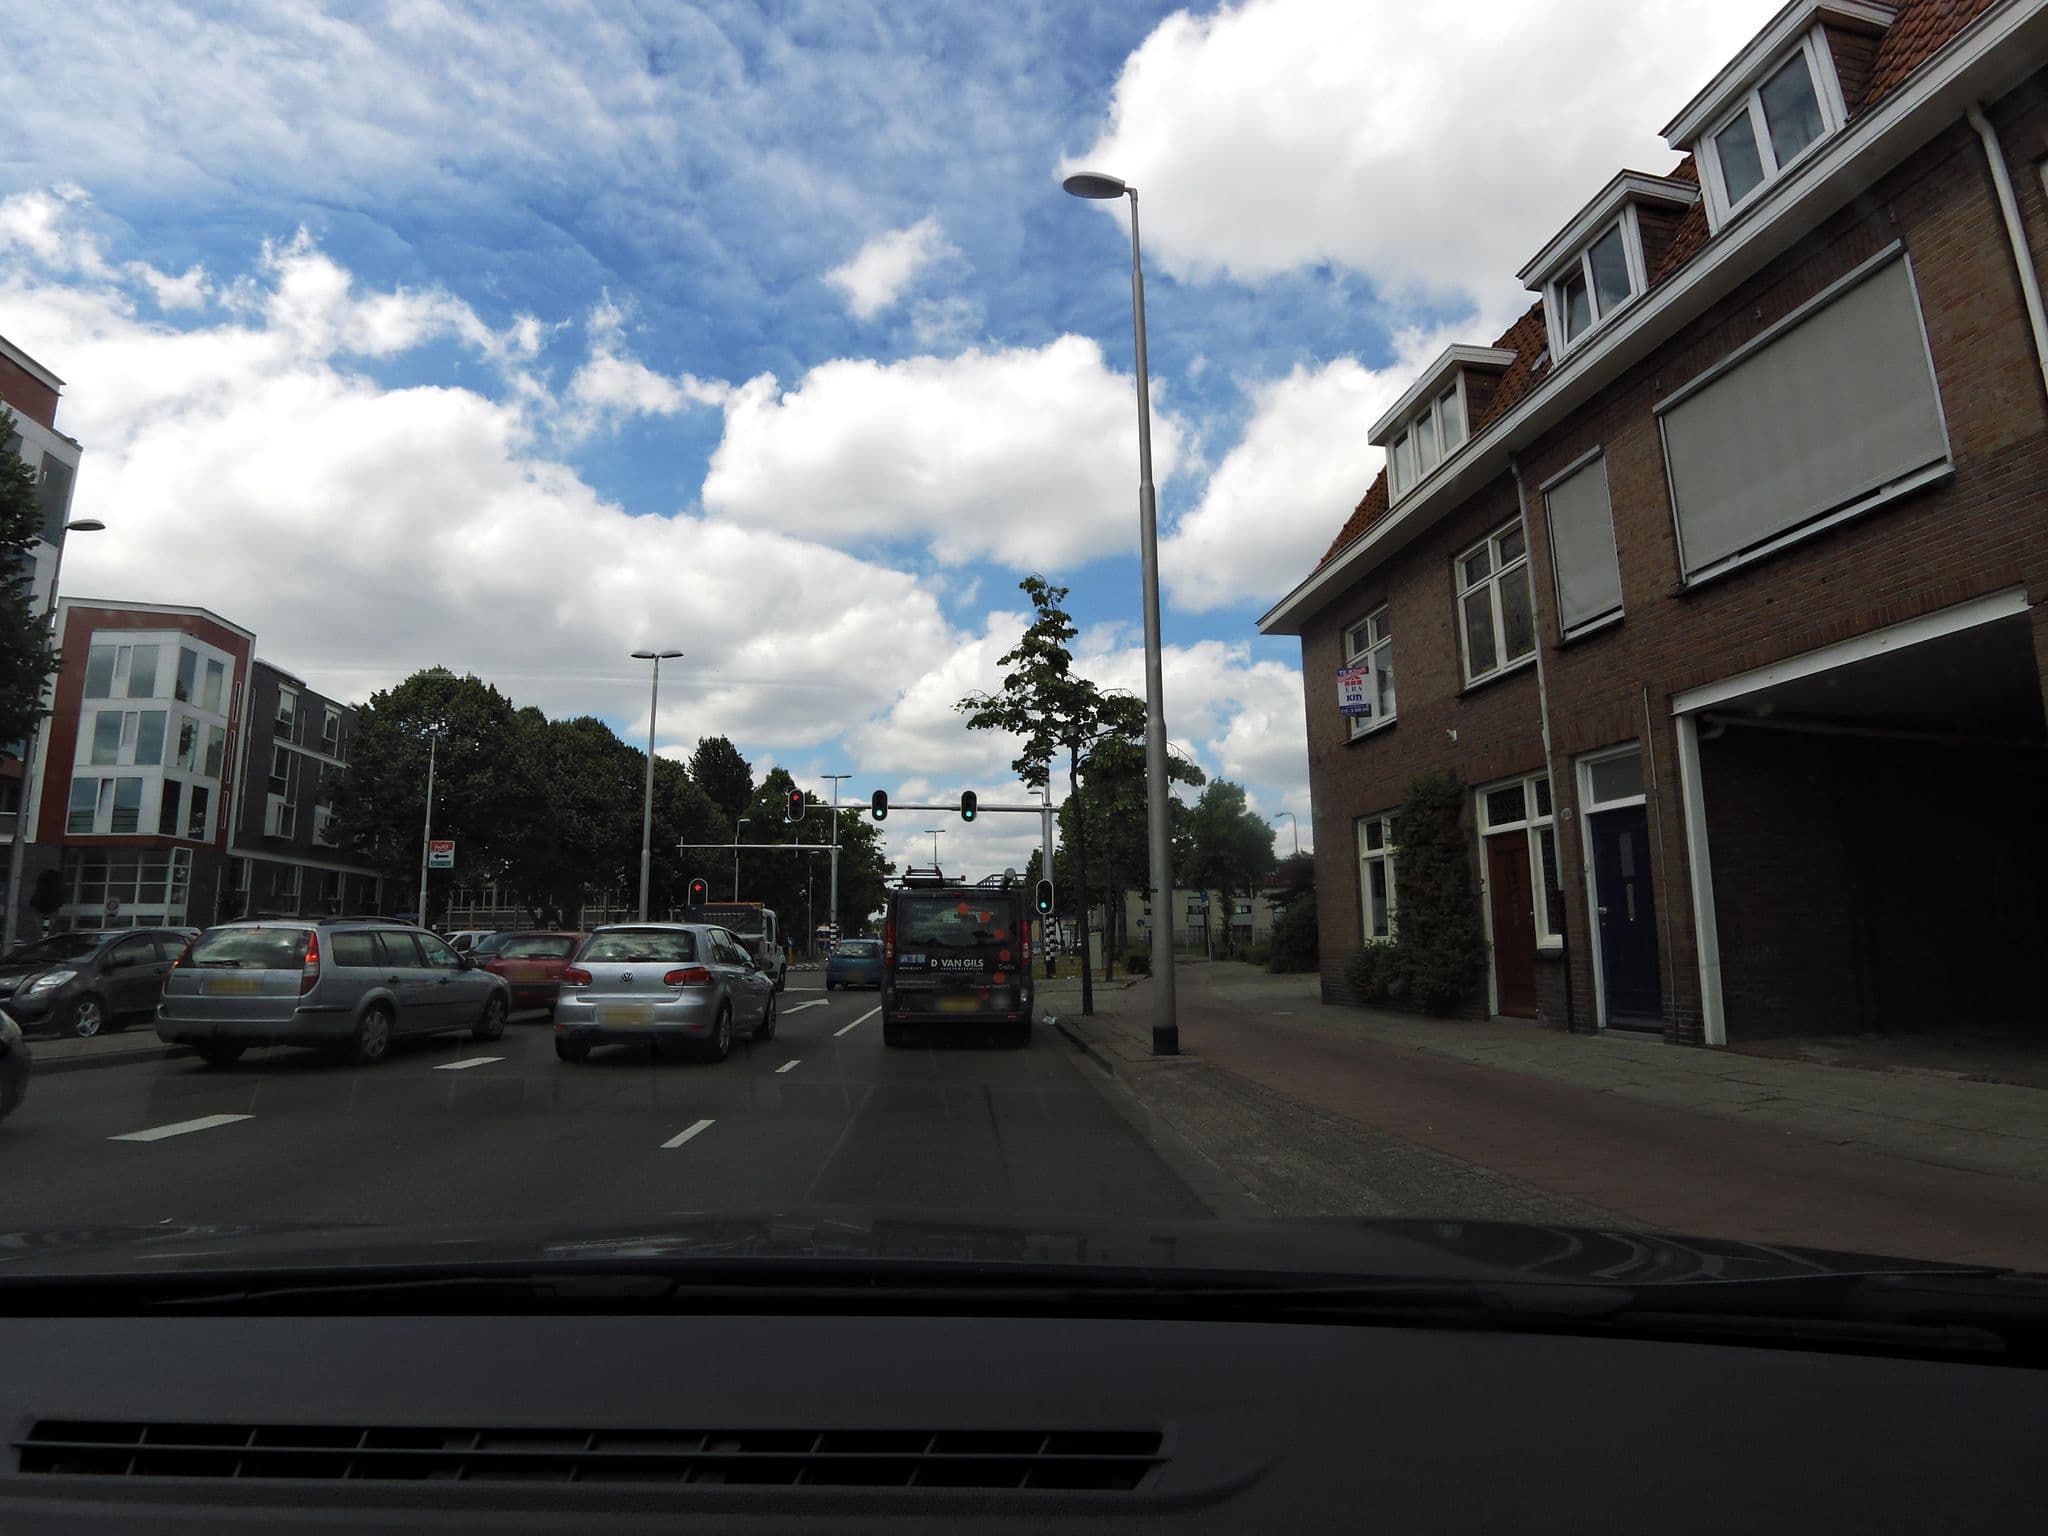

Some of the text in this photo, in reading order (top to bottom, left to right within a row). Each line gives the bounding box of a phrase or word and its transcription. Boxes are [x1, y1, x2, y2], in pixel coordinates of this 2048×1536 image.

[930, 959, 984, 967] D VAN GILS
